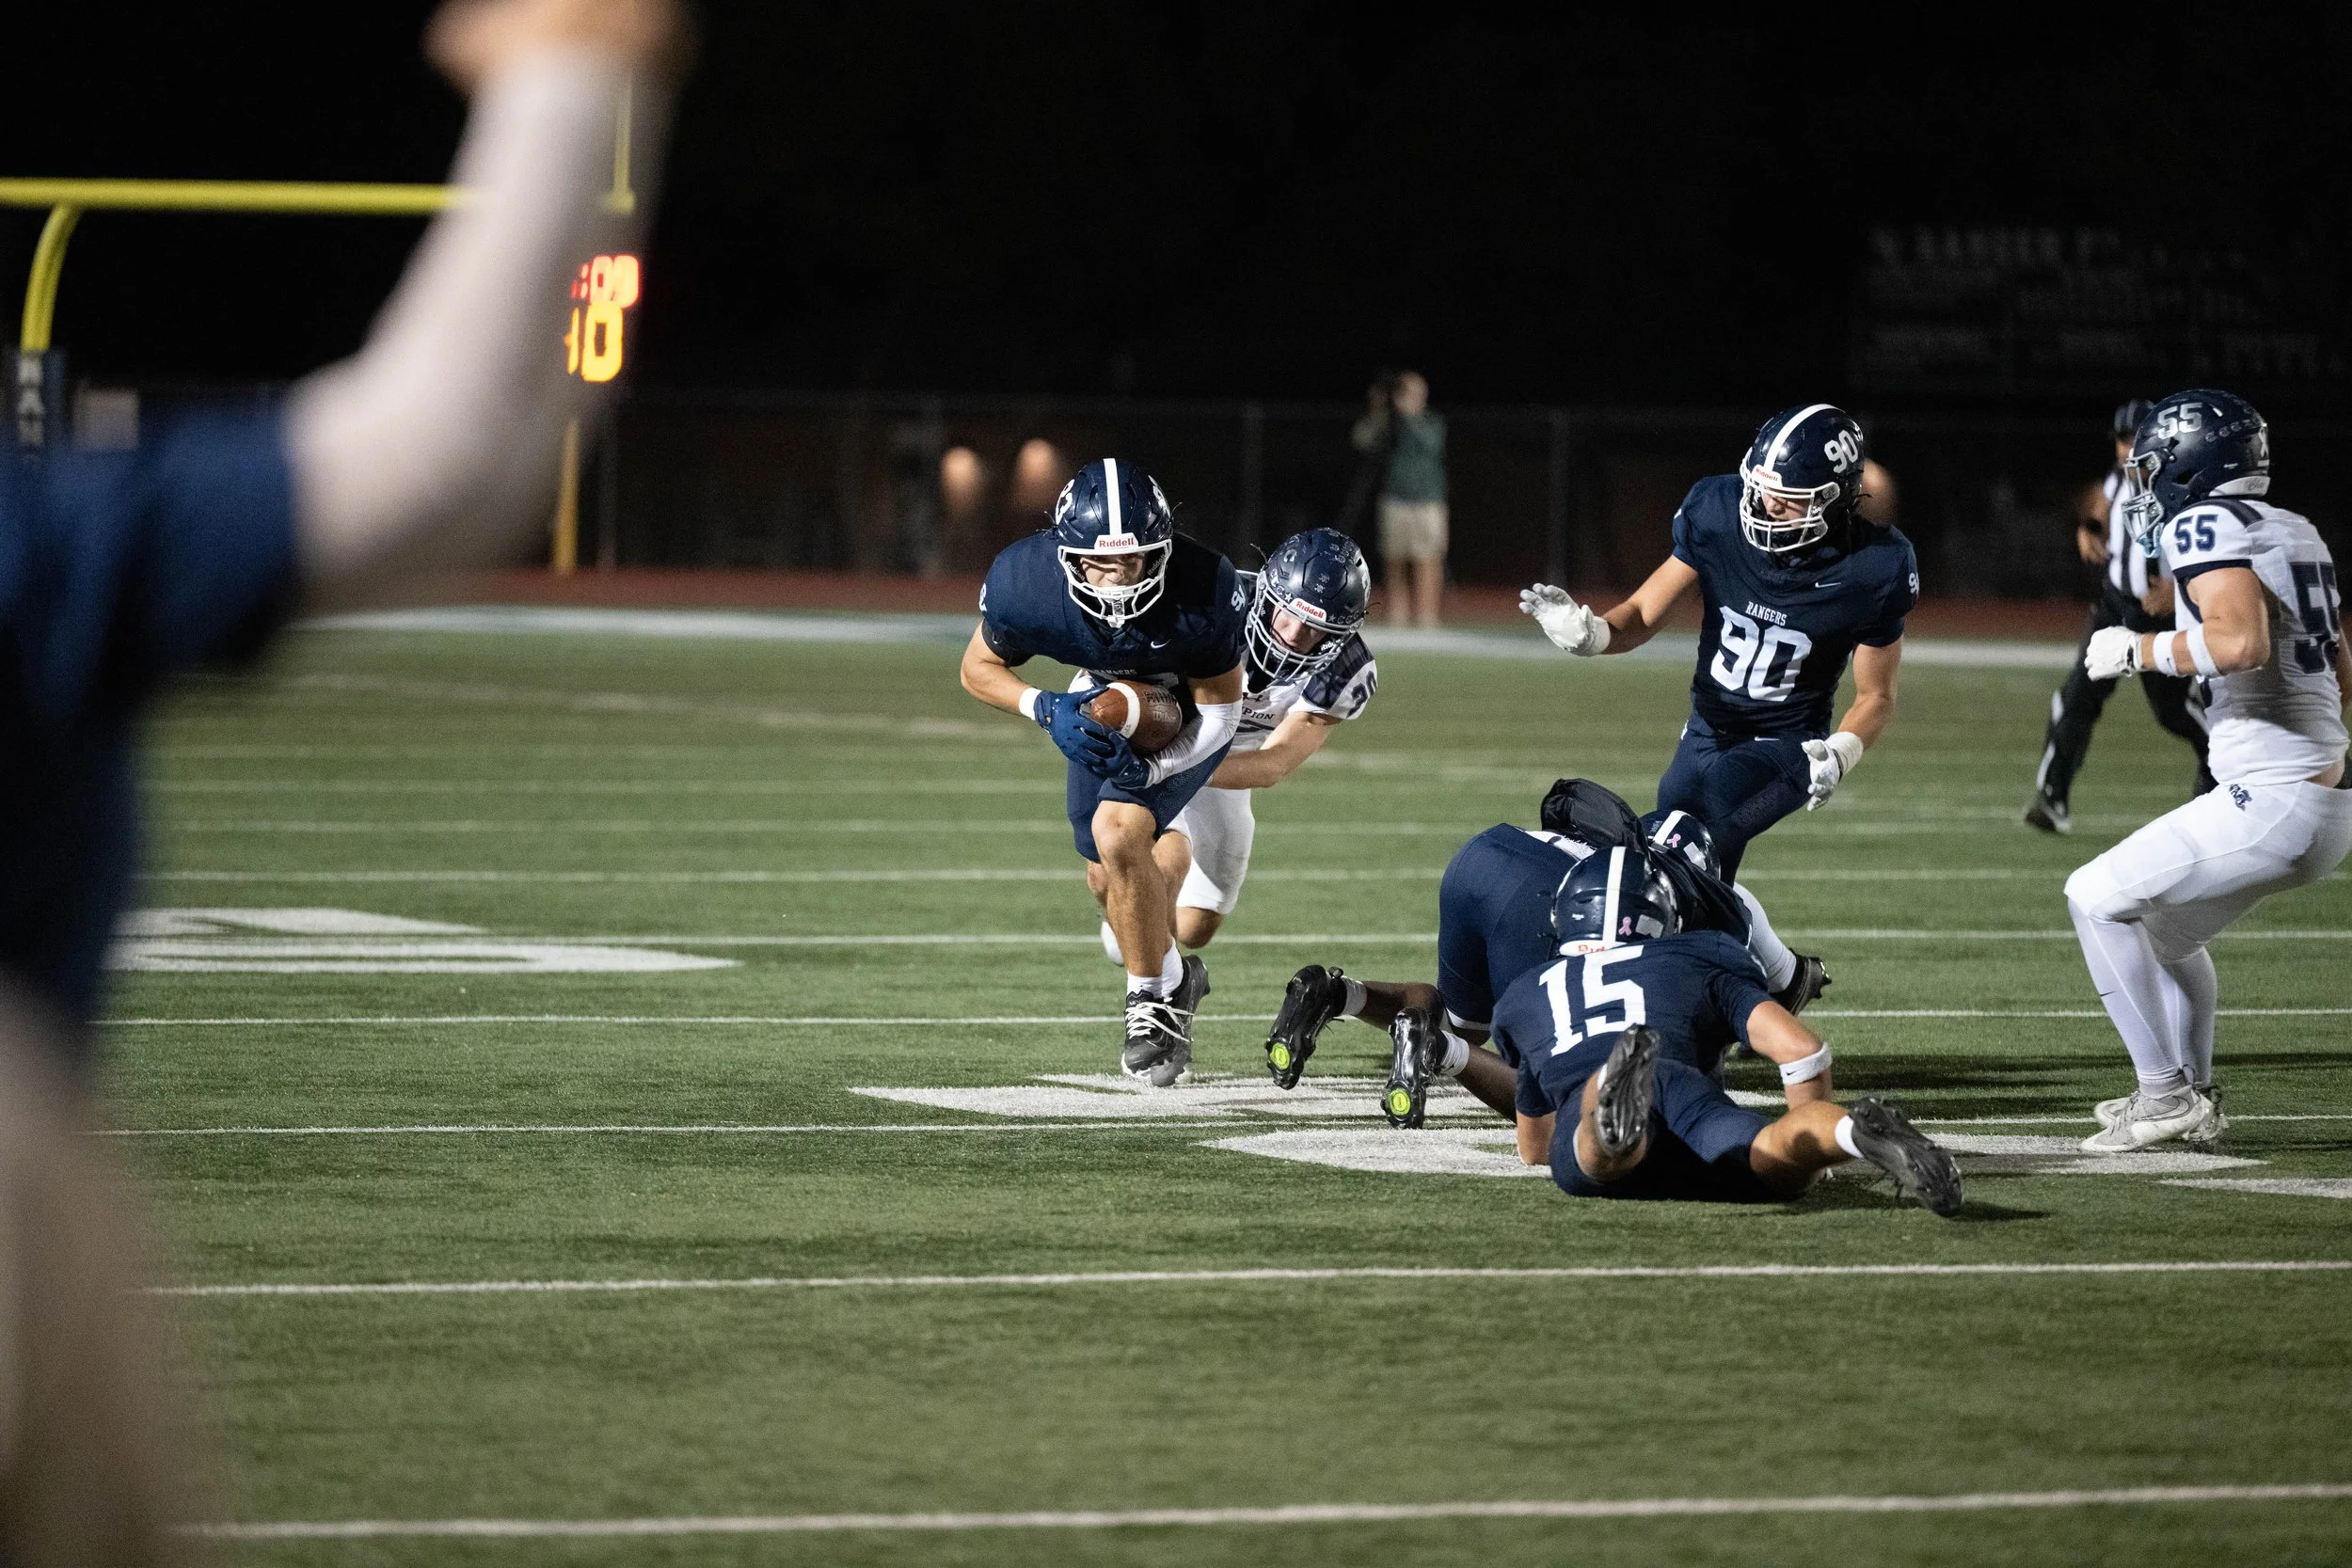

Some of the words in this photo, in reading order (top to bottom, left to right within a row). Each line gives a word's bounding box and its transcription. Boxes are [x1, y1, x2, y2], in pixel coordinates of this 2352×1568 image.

[2156, 402, 2203, 440] 55
[1824, 429, 1859, 473] 90
[1099, 537, 1135, 548] Riddell
[2174, 514, 2218, 555] 55
[1295, 601, 1325, 620] Riddell
[1745, 601, 1788, 626] RANGERS
[1710, 606, 1813, 702] 90
[1538, 944, 1646, 1056] 15
